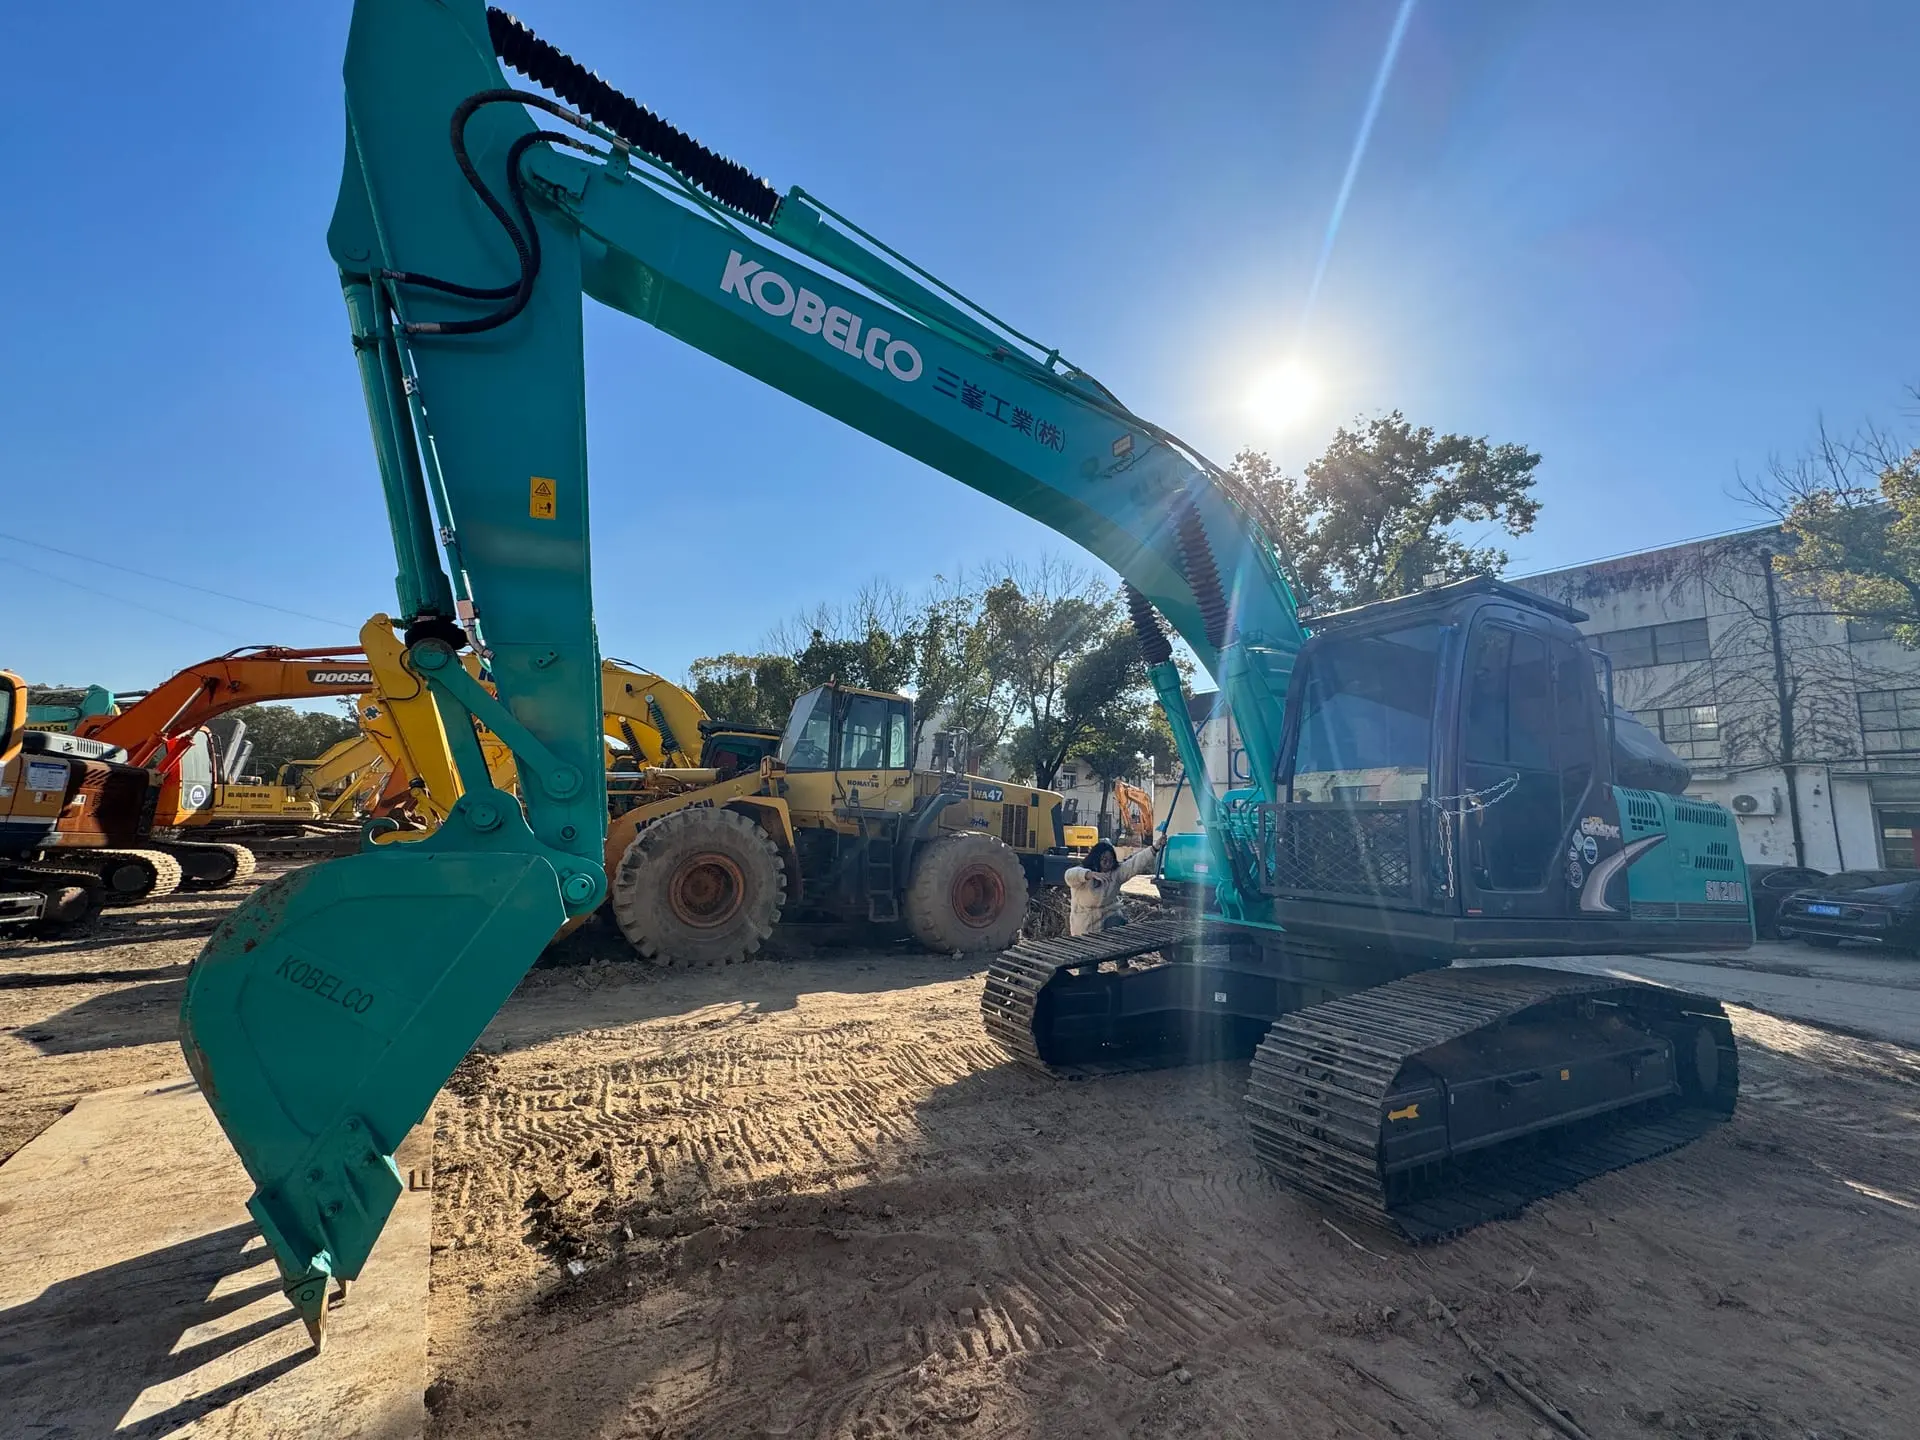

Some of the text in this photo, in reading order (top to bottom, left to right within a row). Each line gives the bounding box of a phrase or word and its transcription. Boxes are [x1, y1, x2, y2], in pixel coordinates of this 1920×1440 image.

[720, 249, 923, 382] KOBELCO
[313, 673, 373, 683] DOOSA
[276, 954, 374, 1014] KOBELCO
